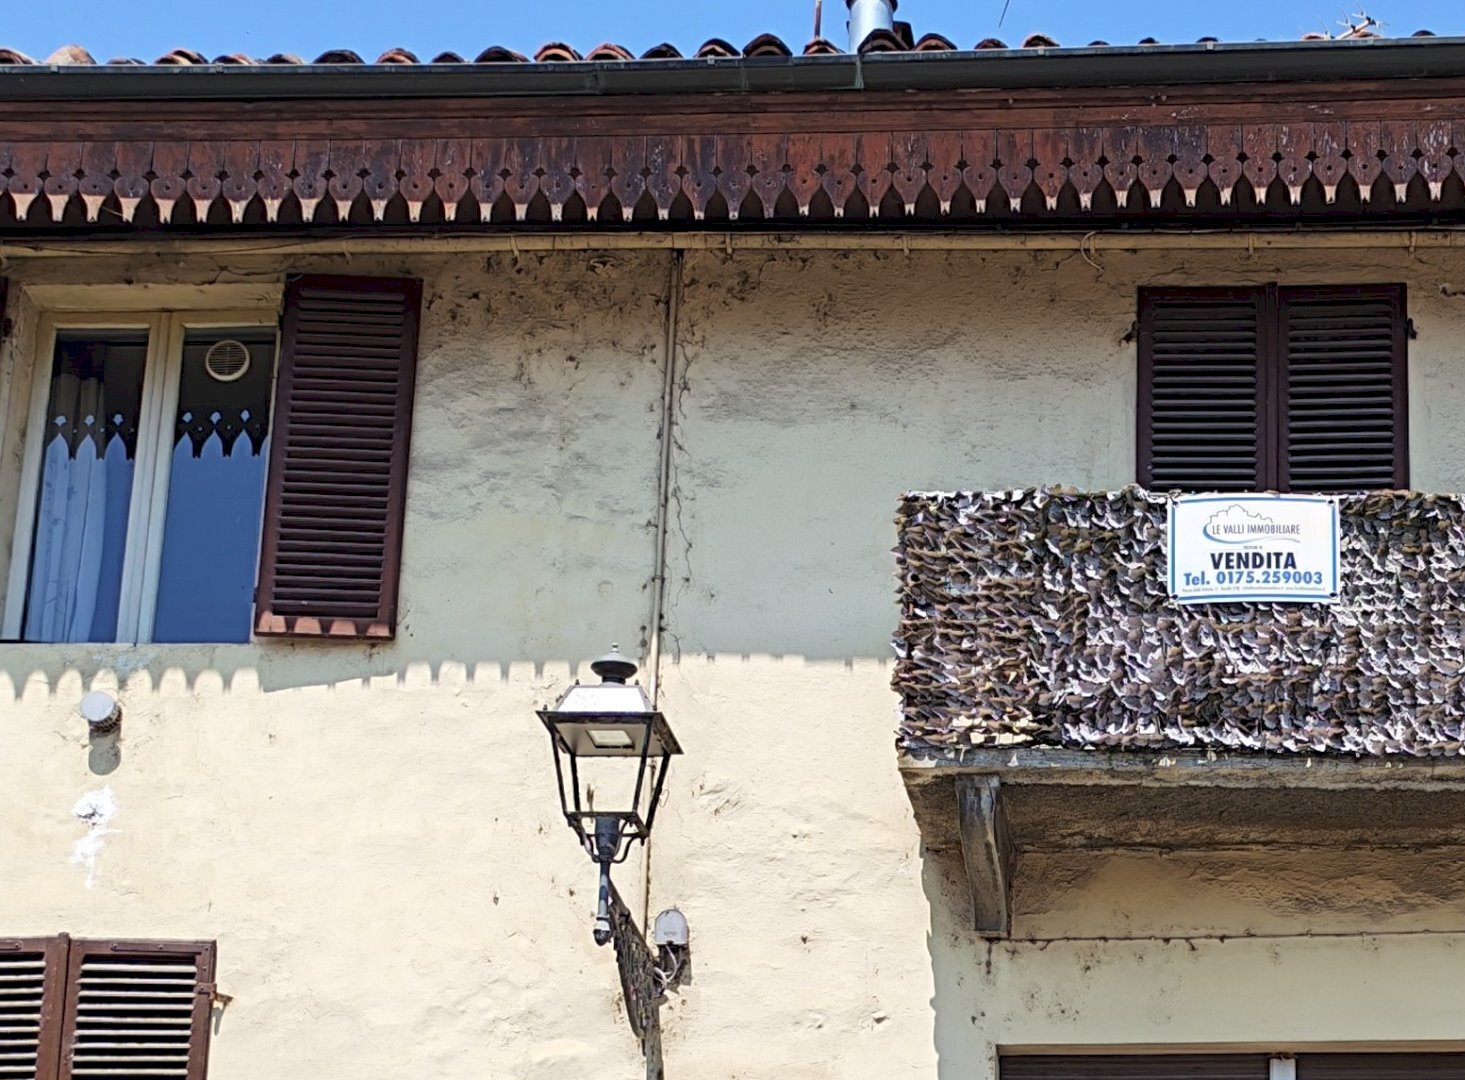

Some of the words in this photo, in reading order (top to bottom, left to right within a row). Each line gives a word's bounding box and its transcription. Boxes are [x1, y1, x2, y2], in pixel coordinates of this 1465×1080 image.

[1212, 525, 1221, 535] LE
[1223, 525, 1245, 534] VALLI
[1247, 524, 1301, 534] IMMOBILIARE
[1210, 552, 1297, 570] VENDITA
[1183, 572, 1210, 586] Tel.
[1216, 571, 1323, 585] 0175.259003
